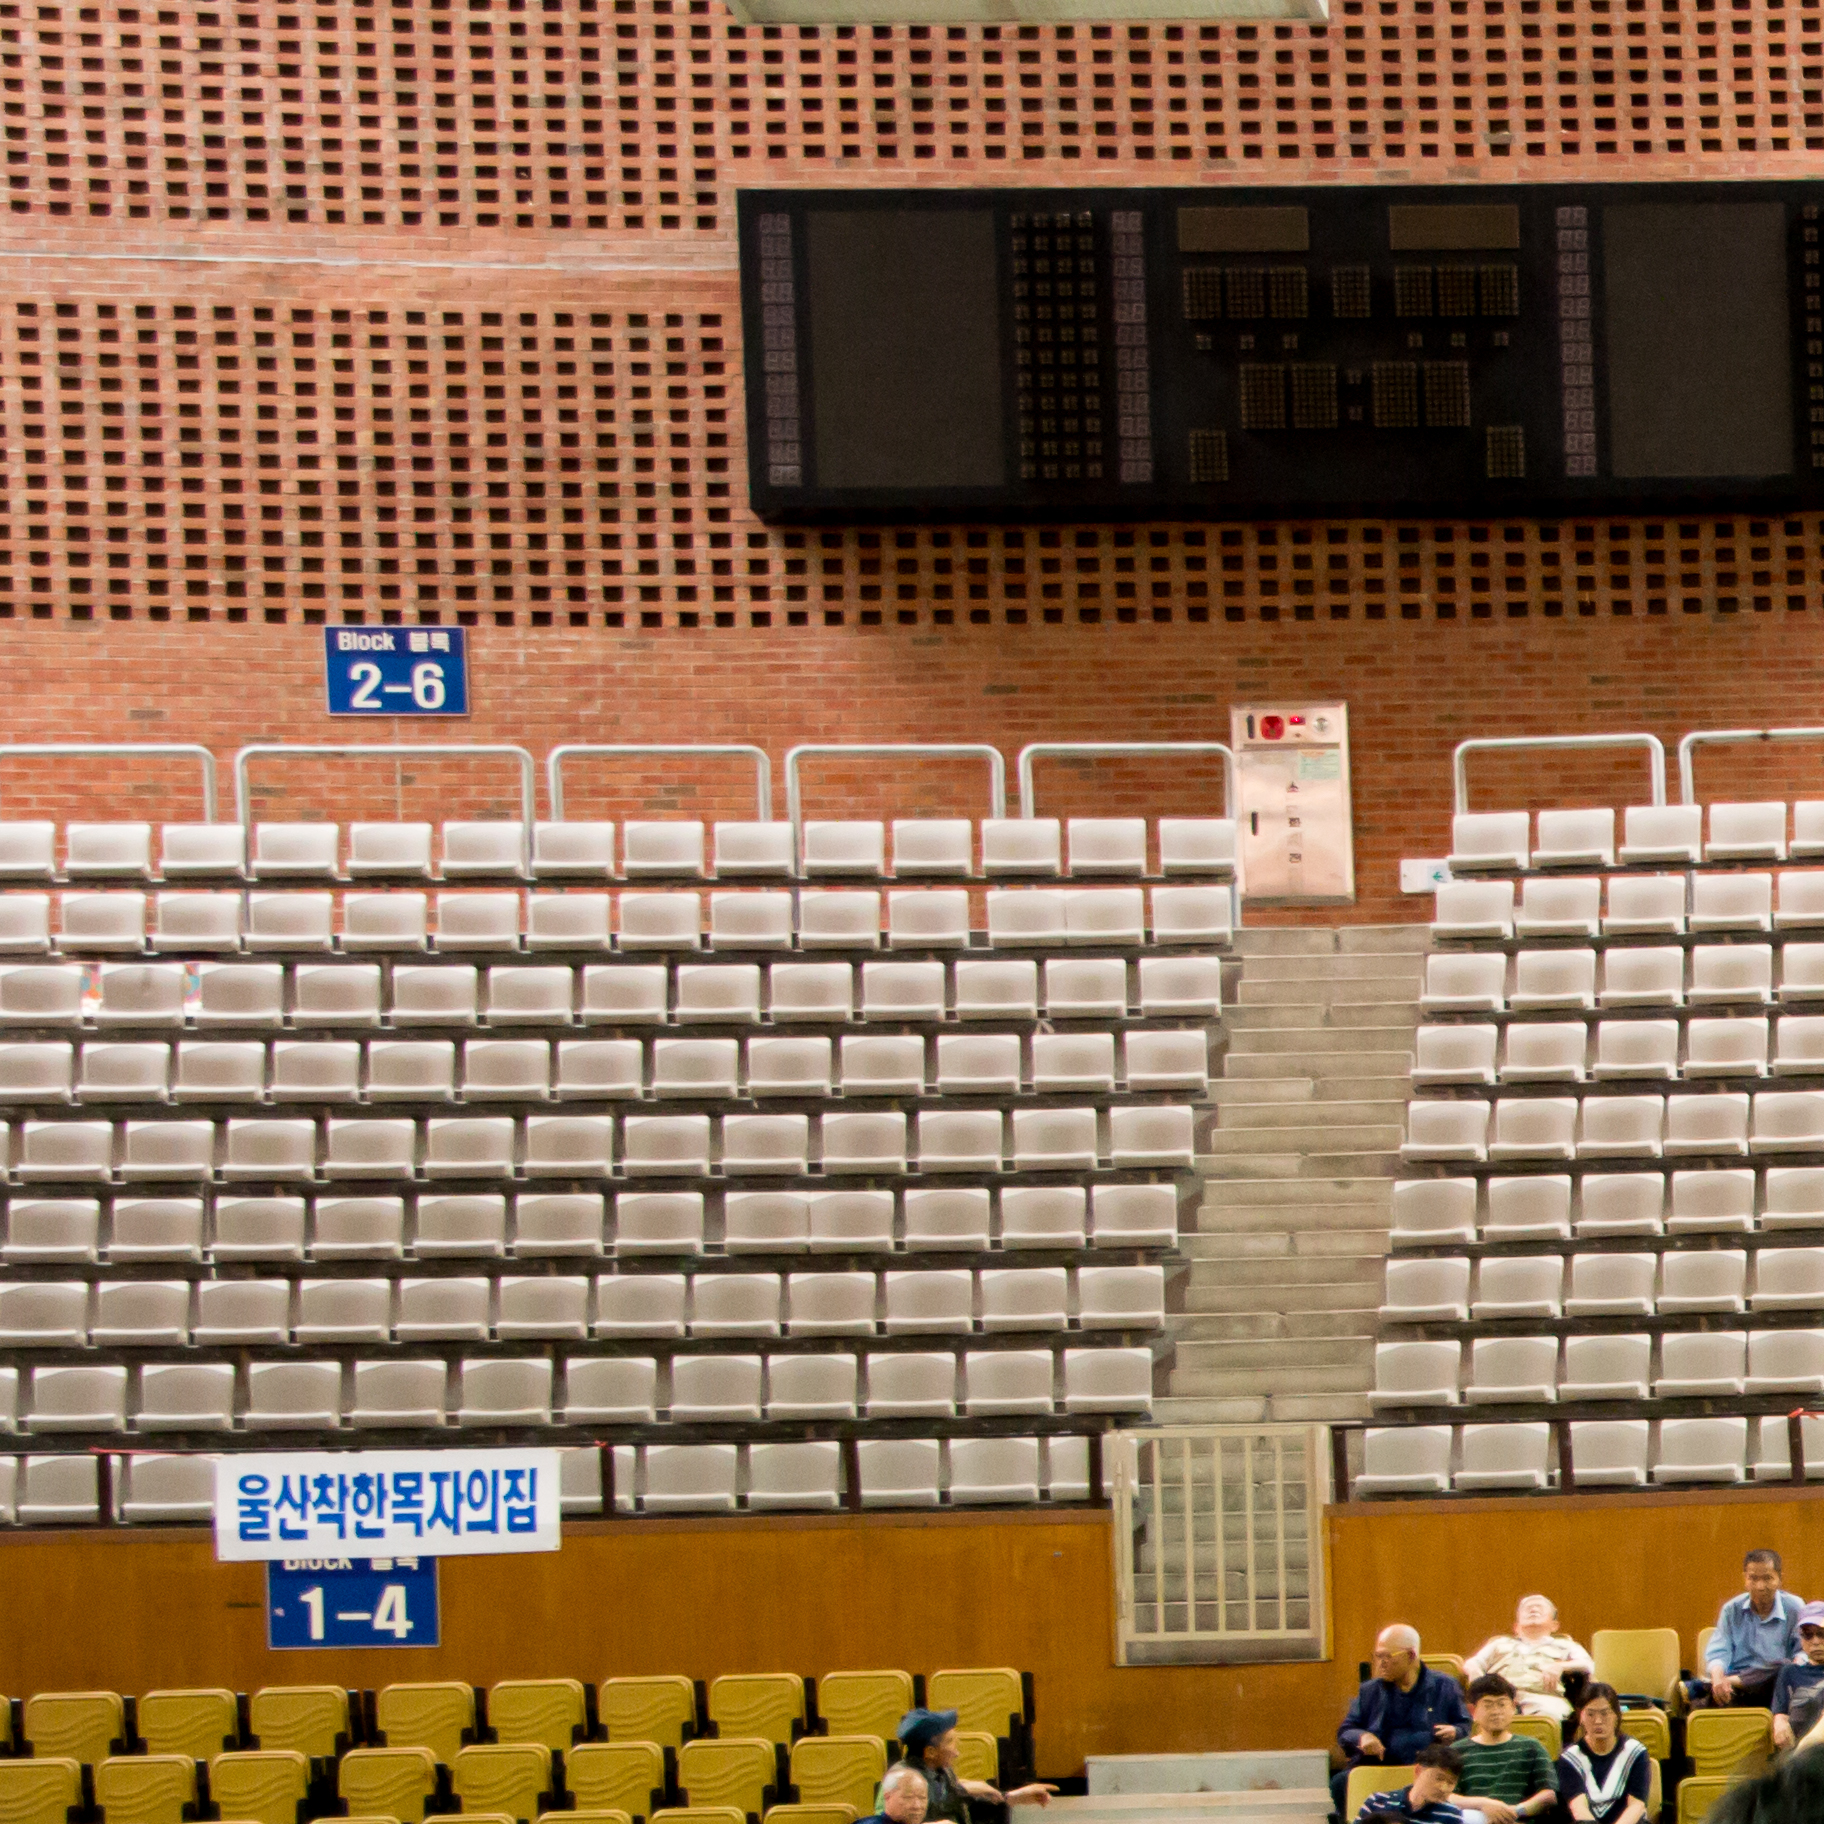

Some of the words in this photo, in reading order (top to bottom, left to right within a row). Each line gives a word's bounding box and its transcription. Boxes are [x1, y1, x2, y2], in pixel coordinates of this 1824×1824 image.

[337, 630, 396, 651] Block
[408, 631, 450, 653] 블록
[348, 662, 447, 709] 2-6
[236, 1467, 539, 1542] 울산착한목자의집
[298, 1585, 415, 1641] 1-4
